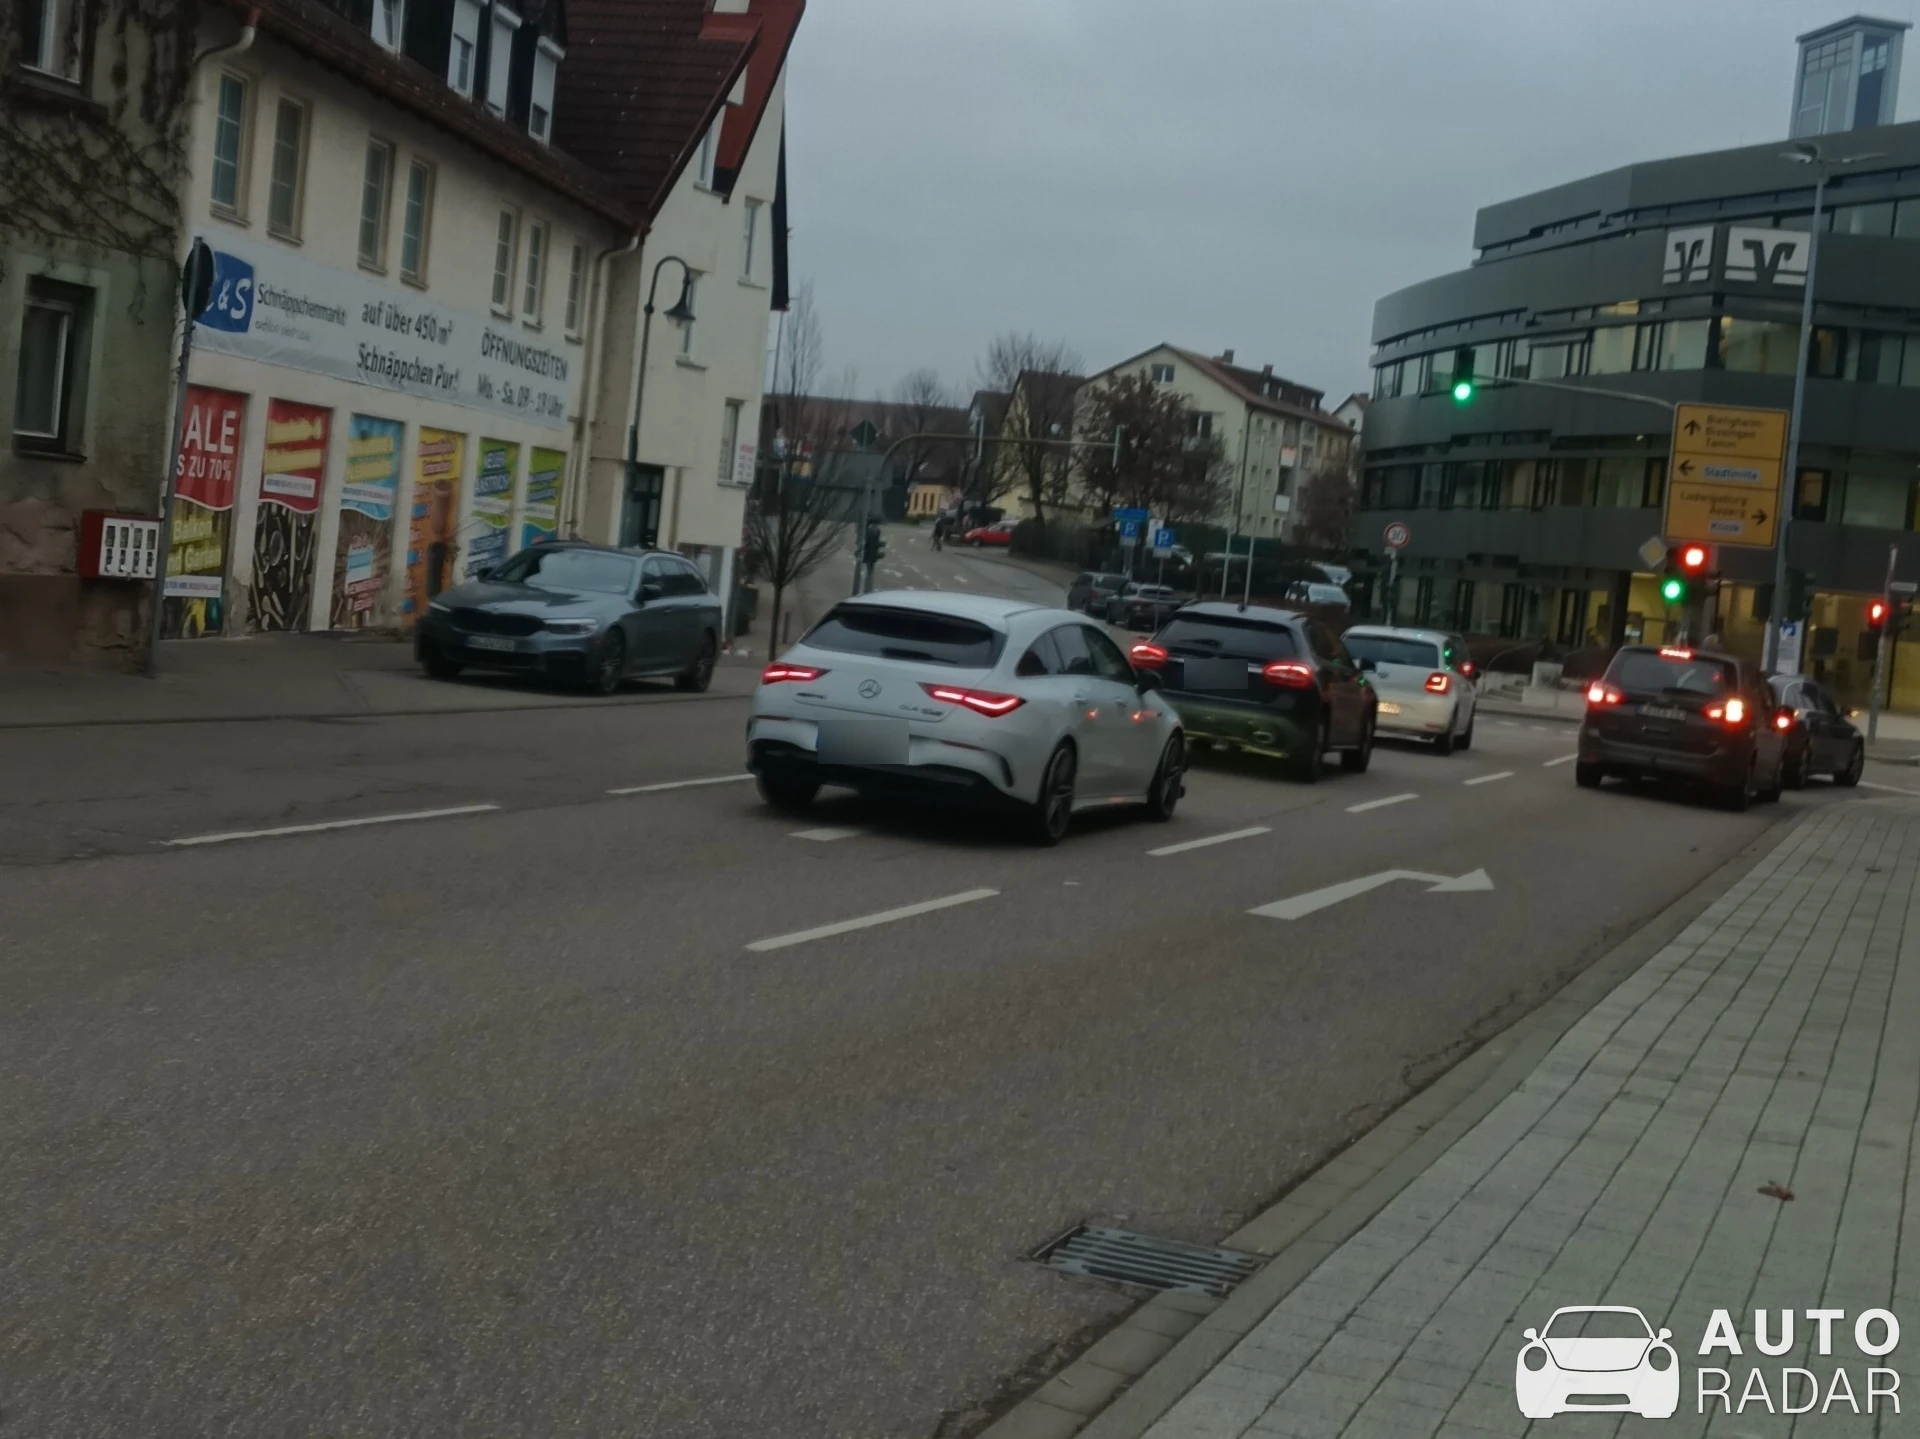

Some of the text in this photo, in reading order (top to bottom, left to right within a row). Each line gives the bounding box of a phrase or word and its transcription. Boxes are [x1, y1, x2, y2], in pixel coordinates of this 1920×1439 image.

[257, 283, 348, 327] Schnäppchenmarkt
[361, 300, 384, 326] auf
[385, 303, 413, 335] über
[414, 313, 438, 342] 450
[357, 342, 434, 386] Schnäppchen
[481, 326, 569, 382] ÖFFNUNGSZEITEN
[180, 404, 237, 454] ALE
[187, 456, 207, 479] ZU
[208, 458, 233, 481] 70%
